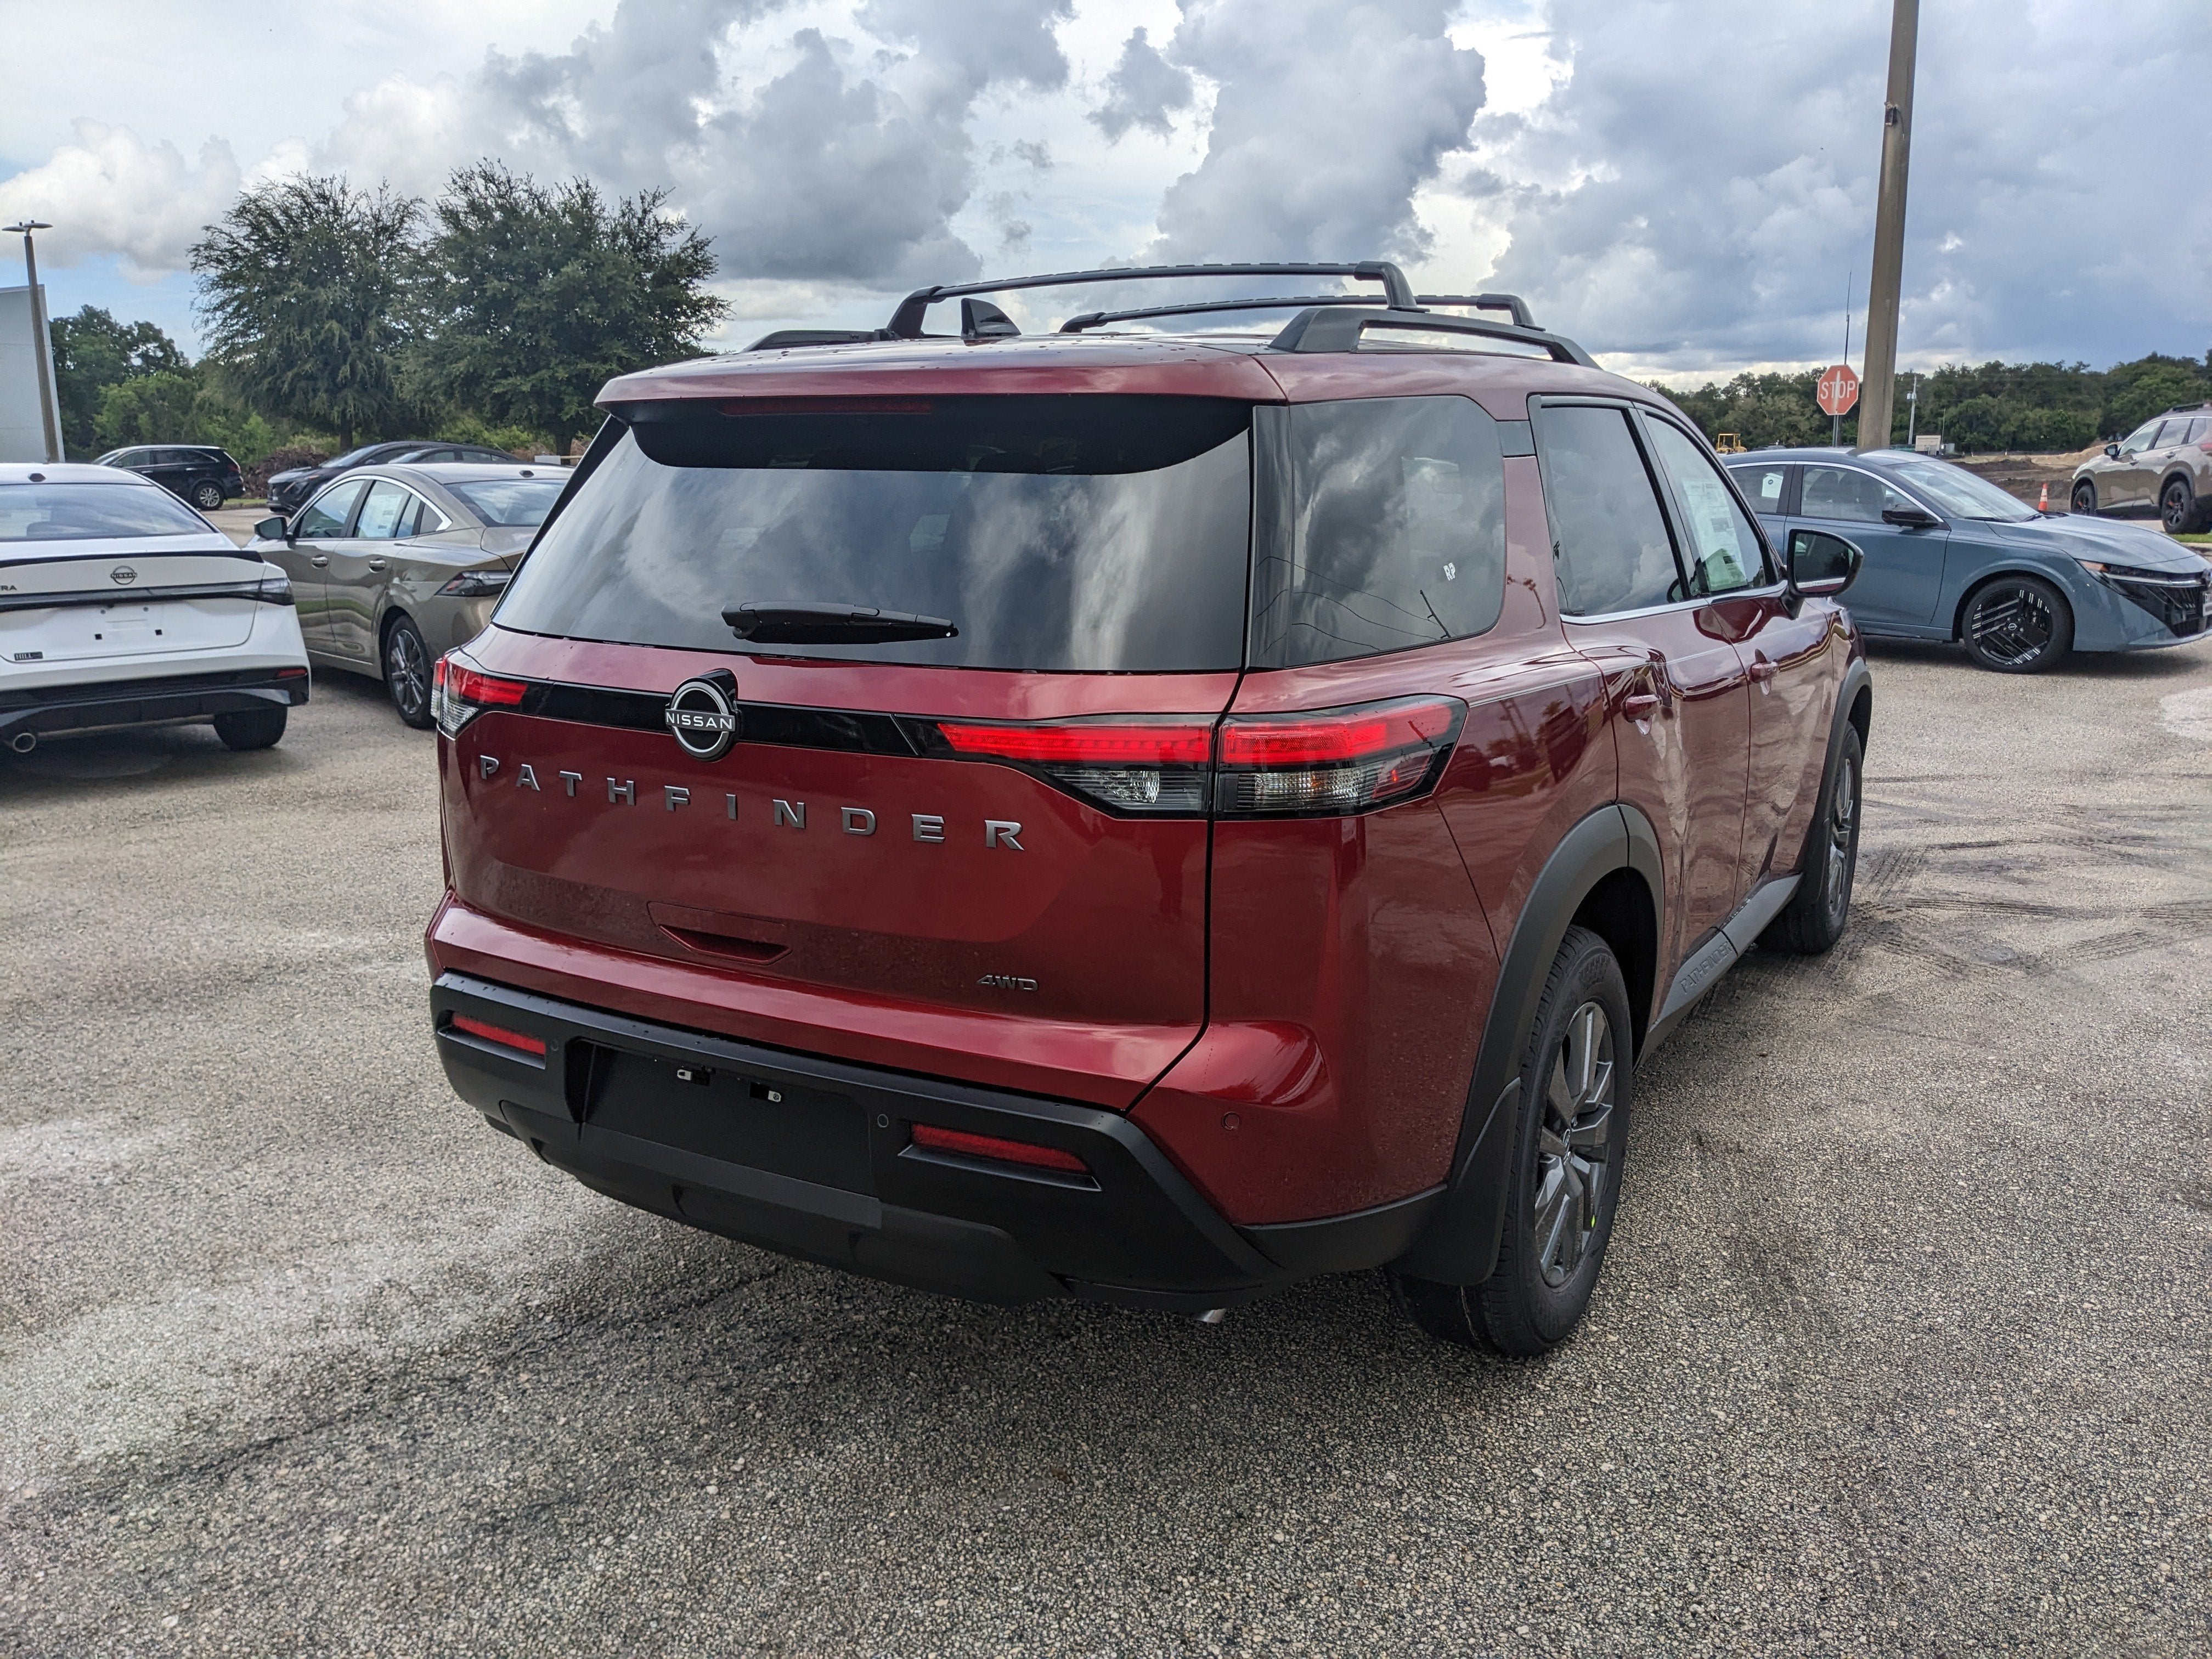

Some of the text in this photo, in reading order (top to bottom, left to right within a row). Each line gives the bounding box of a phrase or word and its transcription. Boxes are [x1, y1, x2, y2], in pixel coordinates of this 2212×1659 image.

[1820, 380, 1856, 400] STOP
[665, 712, 733, 730] NISSAN
[479, 754, 1025, 851] PATHFINDER
[1679, 940, 1733, 995] PATHFINDER
[977, 974, 1039, 992] 4WD
